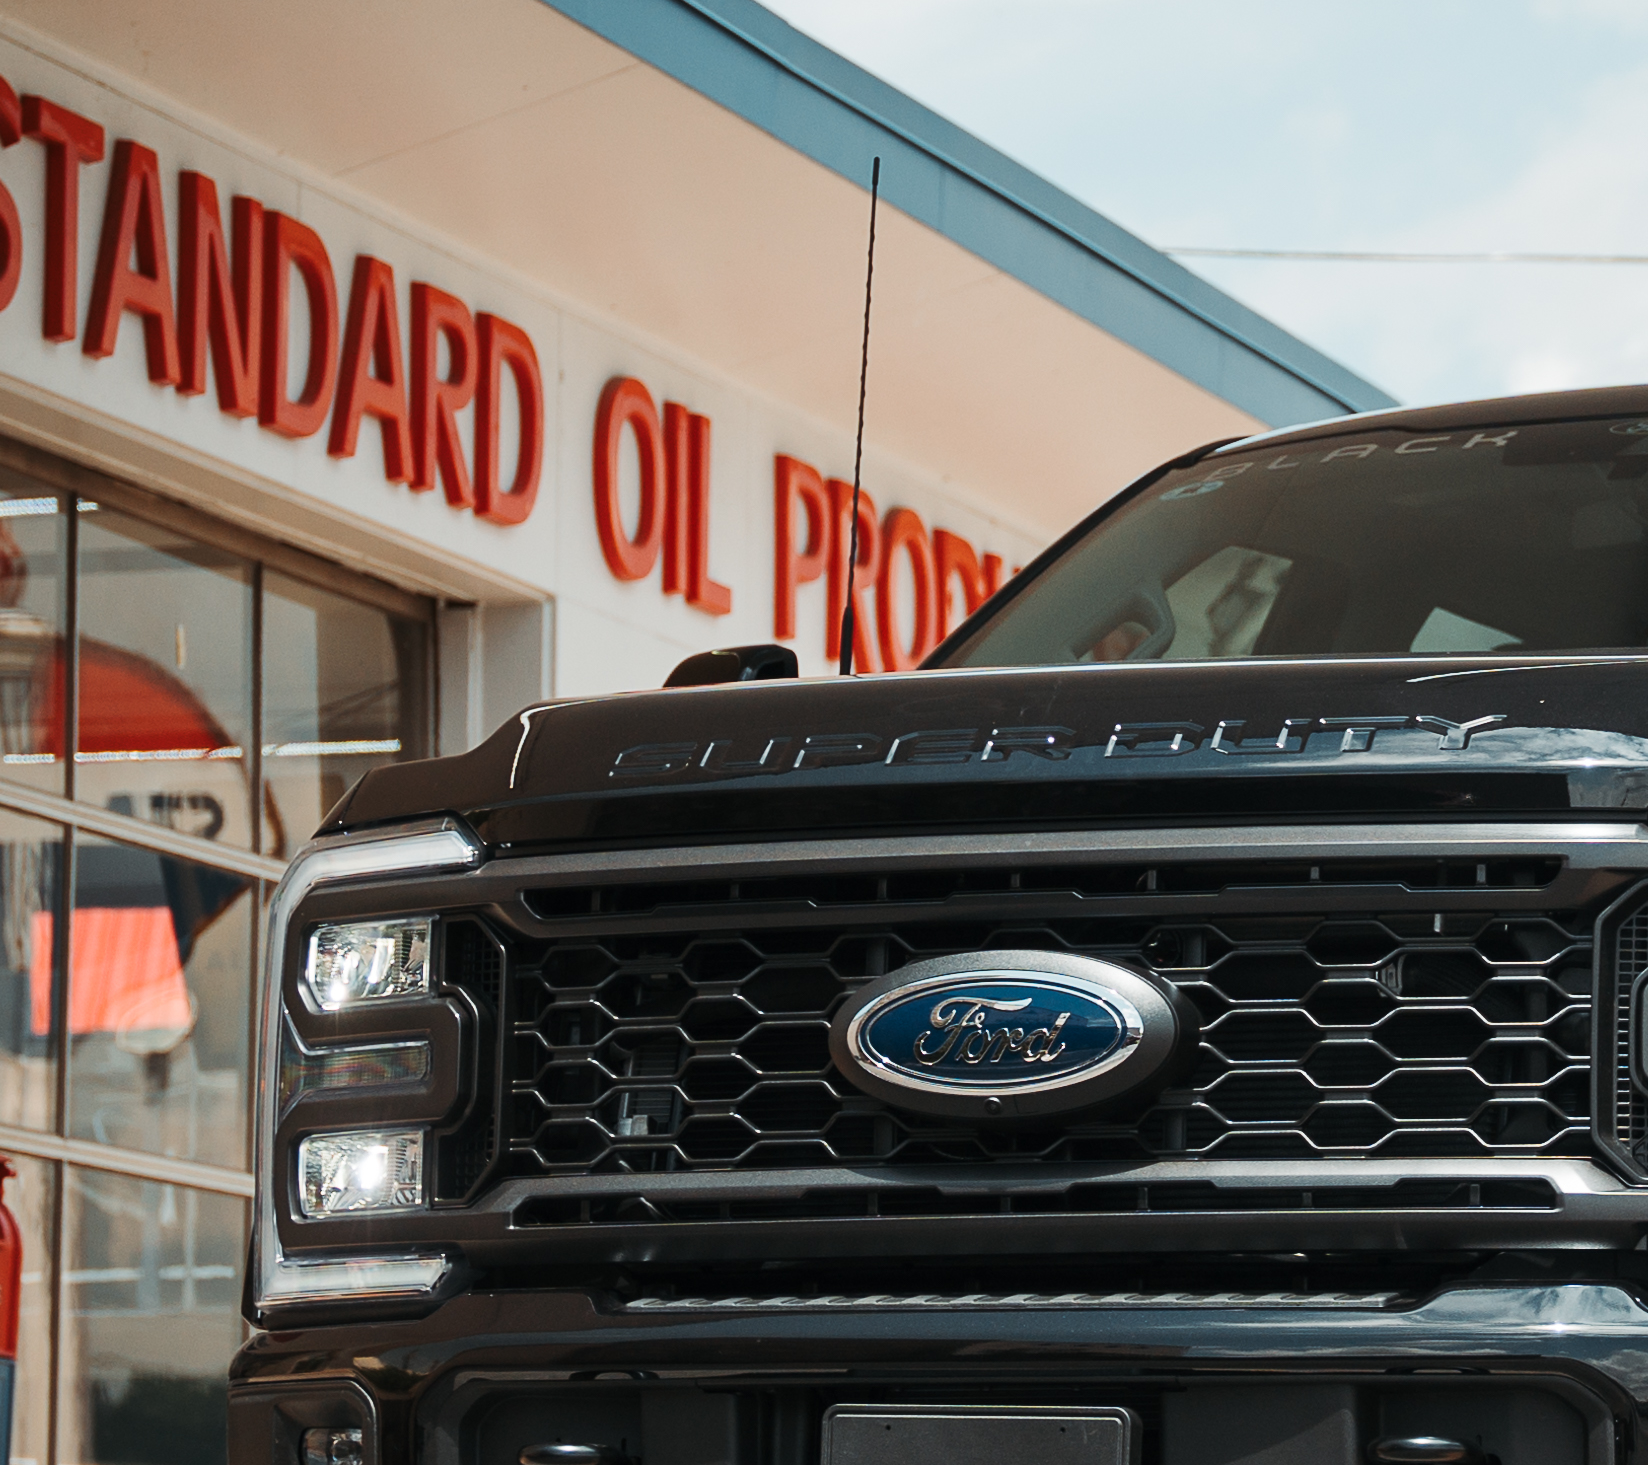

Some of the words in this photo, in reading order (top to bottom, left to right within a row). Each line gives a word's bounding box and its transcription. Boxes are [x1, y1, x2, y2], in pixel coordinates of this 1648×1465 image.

[1202, 430, 1519, 482] BLACK
[592, 375, 731, 615] OIL
[774, 453, 1026, 673] PROD
[606, 725, 1079, 779] SUPER
[1104, 713, 1509, 760] DUTY
[913, 996, 1071, 1066] Ford
